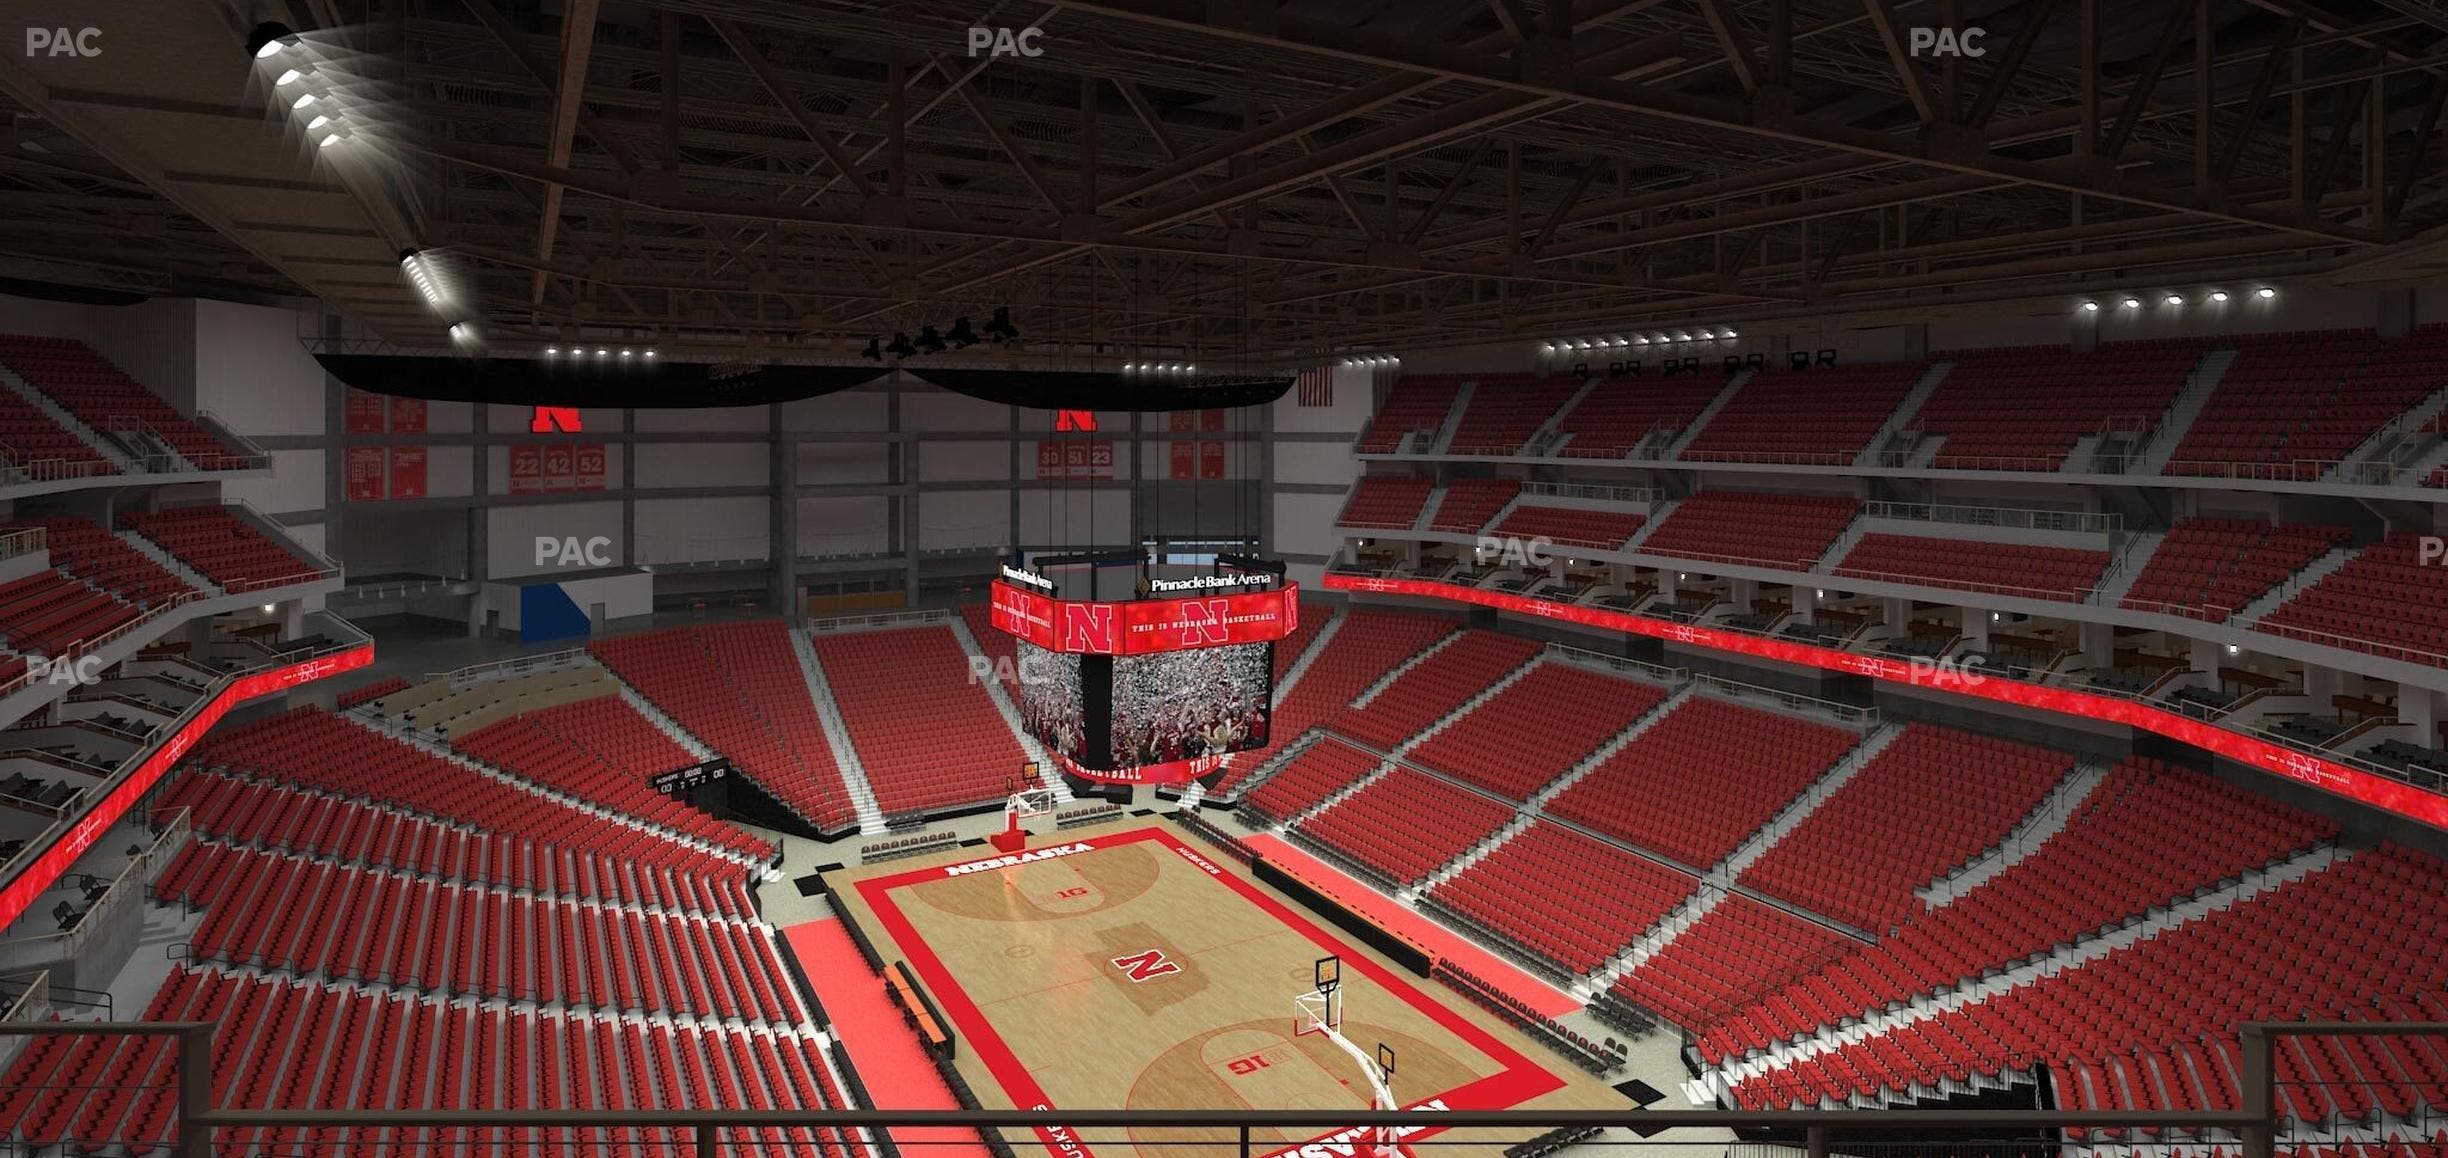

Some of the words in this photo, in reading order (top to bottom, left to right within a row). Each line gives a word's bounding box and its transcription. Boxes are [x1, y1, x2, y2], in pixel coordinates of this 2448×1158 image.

[515, 458, 538, 475] 22
[1152, 576, 1201, 592] Pinnacle
[1206, 574, 1237, 588] Bank
[1237, 573, 1271, 585] Arena
[1066, 603, 1112, 653] N
[1131, 624, 1154, 633] THIS
[1159, 623, 1168, 631] IS
[1223, 613, 1276, 625] BASKETBALL
[1182, 599, 1228, 646] N
[2292, 753, 2320, 784] N
[944, 842, 1096, 877] NEBRASKA
[1176, 847, 1221, 875] HUSKERS
[1112, 948, 1182, 984] N
